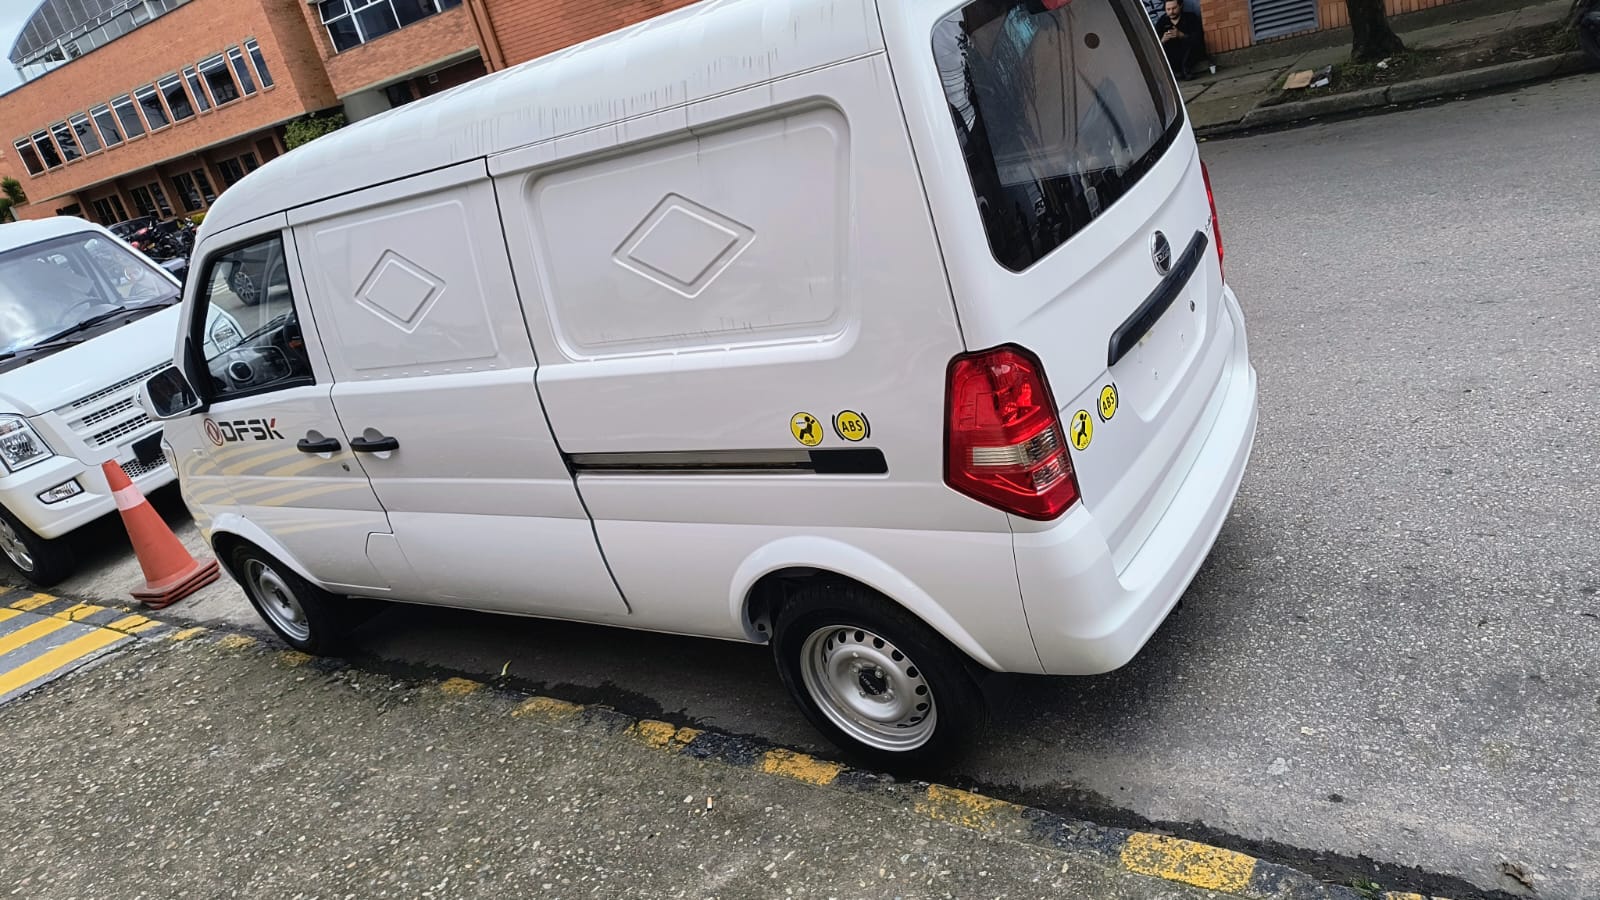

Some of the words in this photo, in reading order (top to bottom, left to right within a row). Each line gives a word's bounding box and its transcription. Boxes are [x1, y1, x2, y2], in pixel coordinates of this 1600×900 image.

[1102, 392, 1115, 414] ABS
[218, 418, 285, 441] DFSK
[841, 420, 863, 433] ABS
